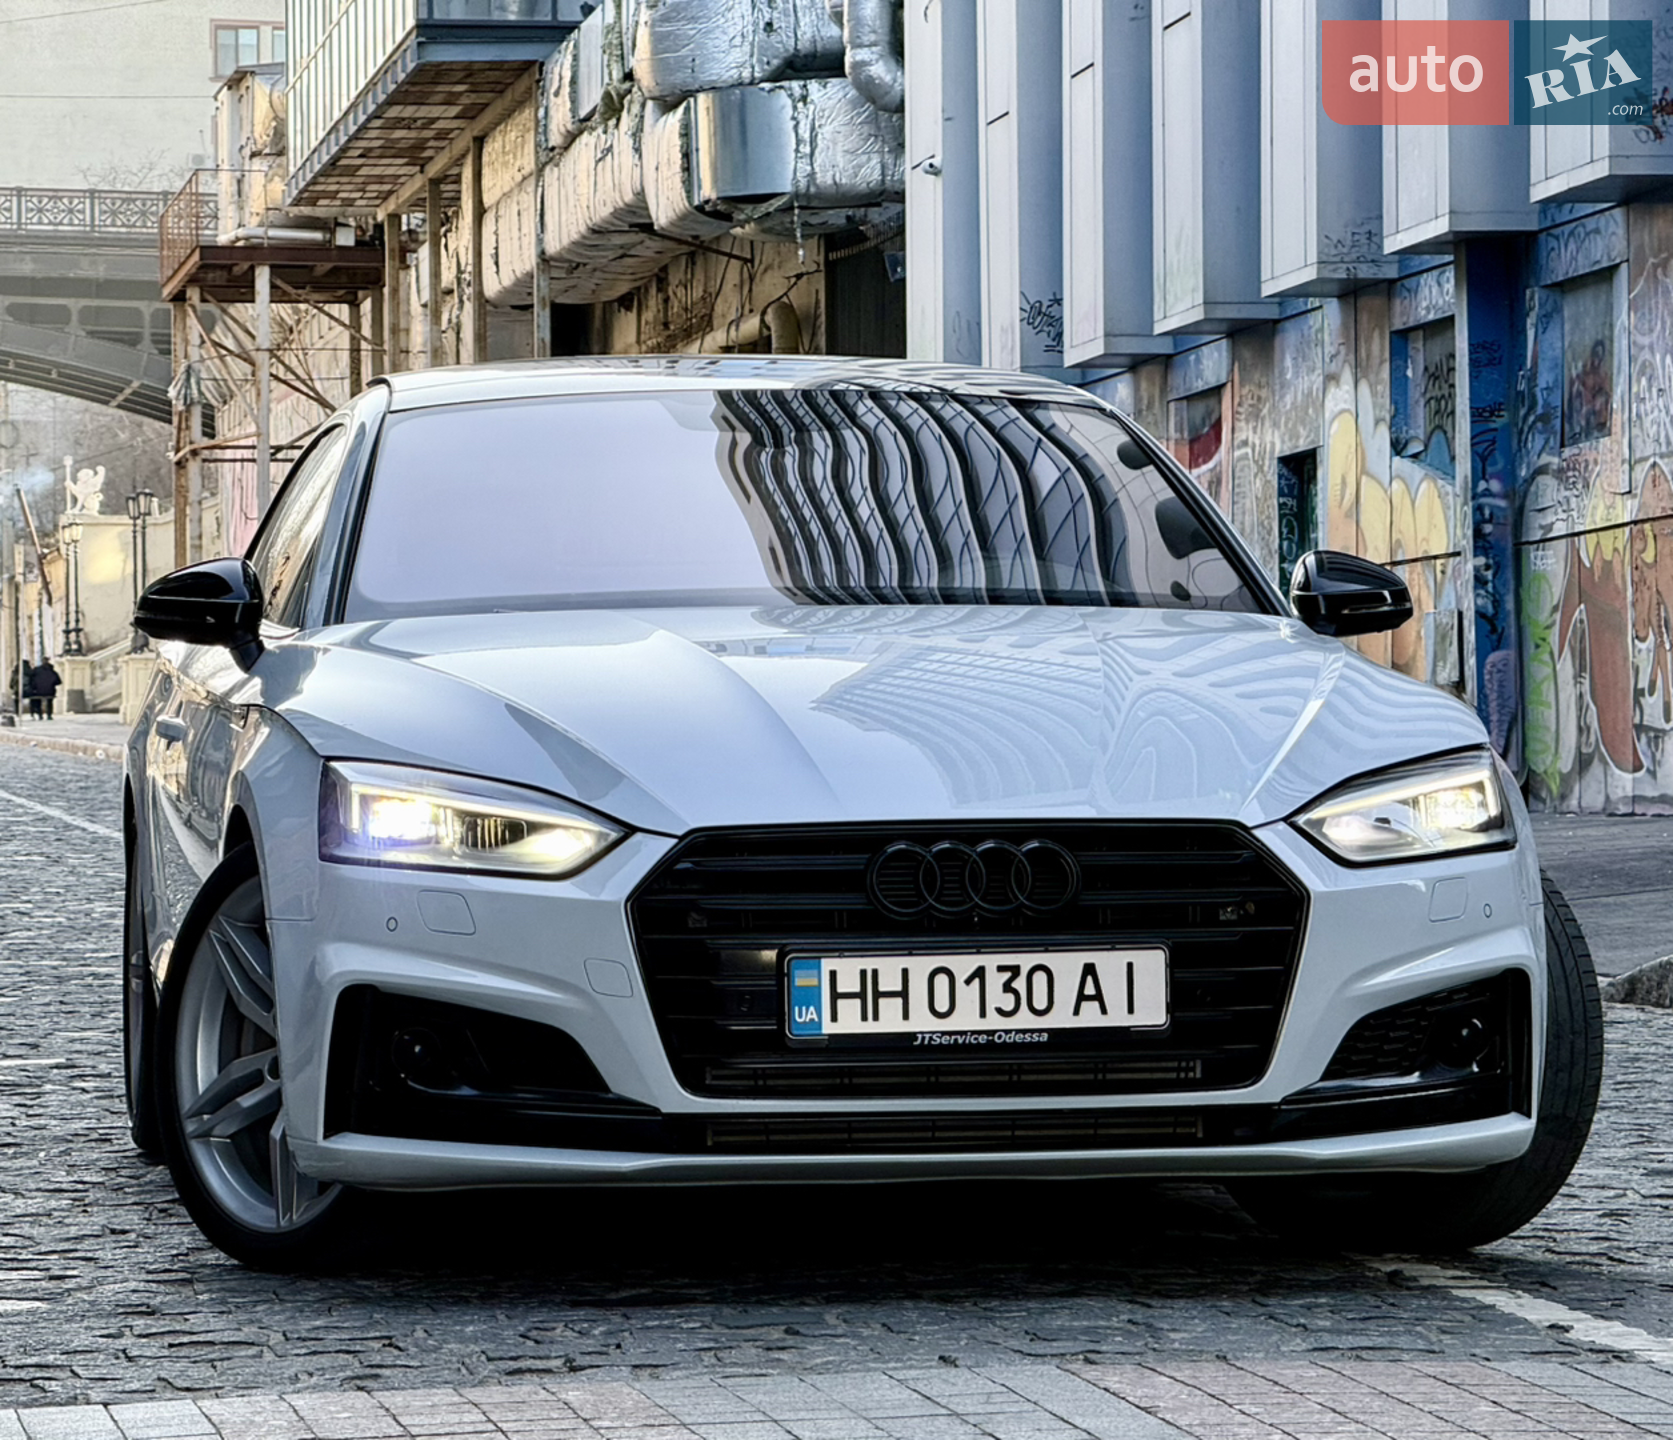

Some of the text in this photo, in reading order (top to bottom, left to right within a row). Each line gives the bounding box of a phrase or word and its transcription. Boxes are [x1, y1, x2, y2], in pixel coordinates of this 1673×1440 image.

[828, 961, 1135, 1023] HH 0130 AI
[794, 1006, 819, 1023] UA
[912, 1030, 1049, 1046] JTService-Odessa
